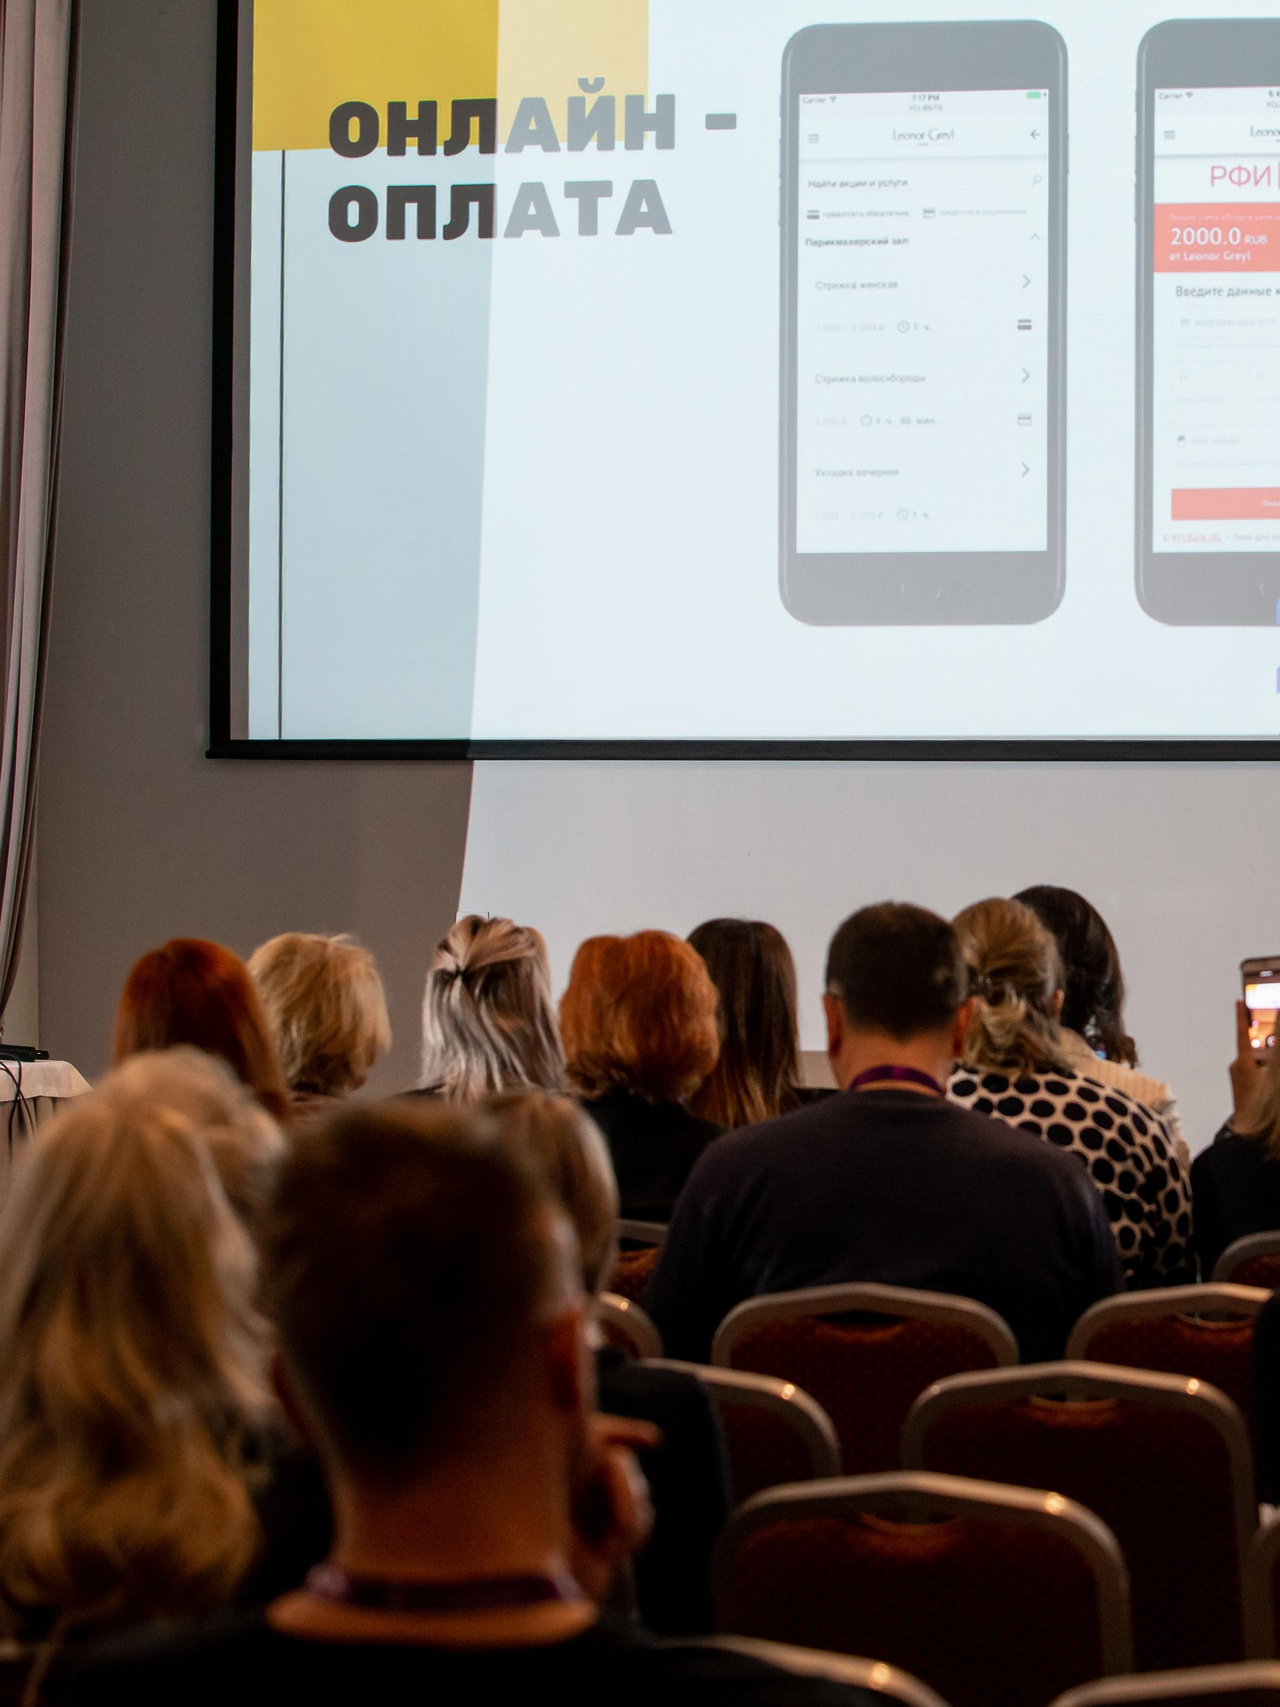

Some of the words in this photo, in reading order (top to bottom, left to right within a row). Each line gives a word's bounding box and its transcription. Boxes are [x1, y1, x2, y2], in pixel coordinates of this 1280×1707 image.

[329, 77, 675, 158] ОНЛАЙН
[1210, 164, 1272, 188] РФИ
[877, 178, 908, 189] услуги
[328, 179, 673, 242] ОПЛАТА
[805, 237, 889, 248] Парикмахерский
[892, 237, 909, 246] зал
[1170, 226, 1242, 246] 2000.0
[1245, 234, 1269, 245] RUB
[1184, 251, 1220, 261] Leonor
[1223, 250, 1251, 264] Greyl
[1176, 285, 1224, 297] Введите
[1226, 286, 1272, 297] данные
[815, 374, 856, 384] Стрижка
[815, 468, 854, 478] Укладка
